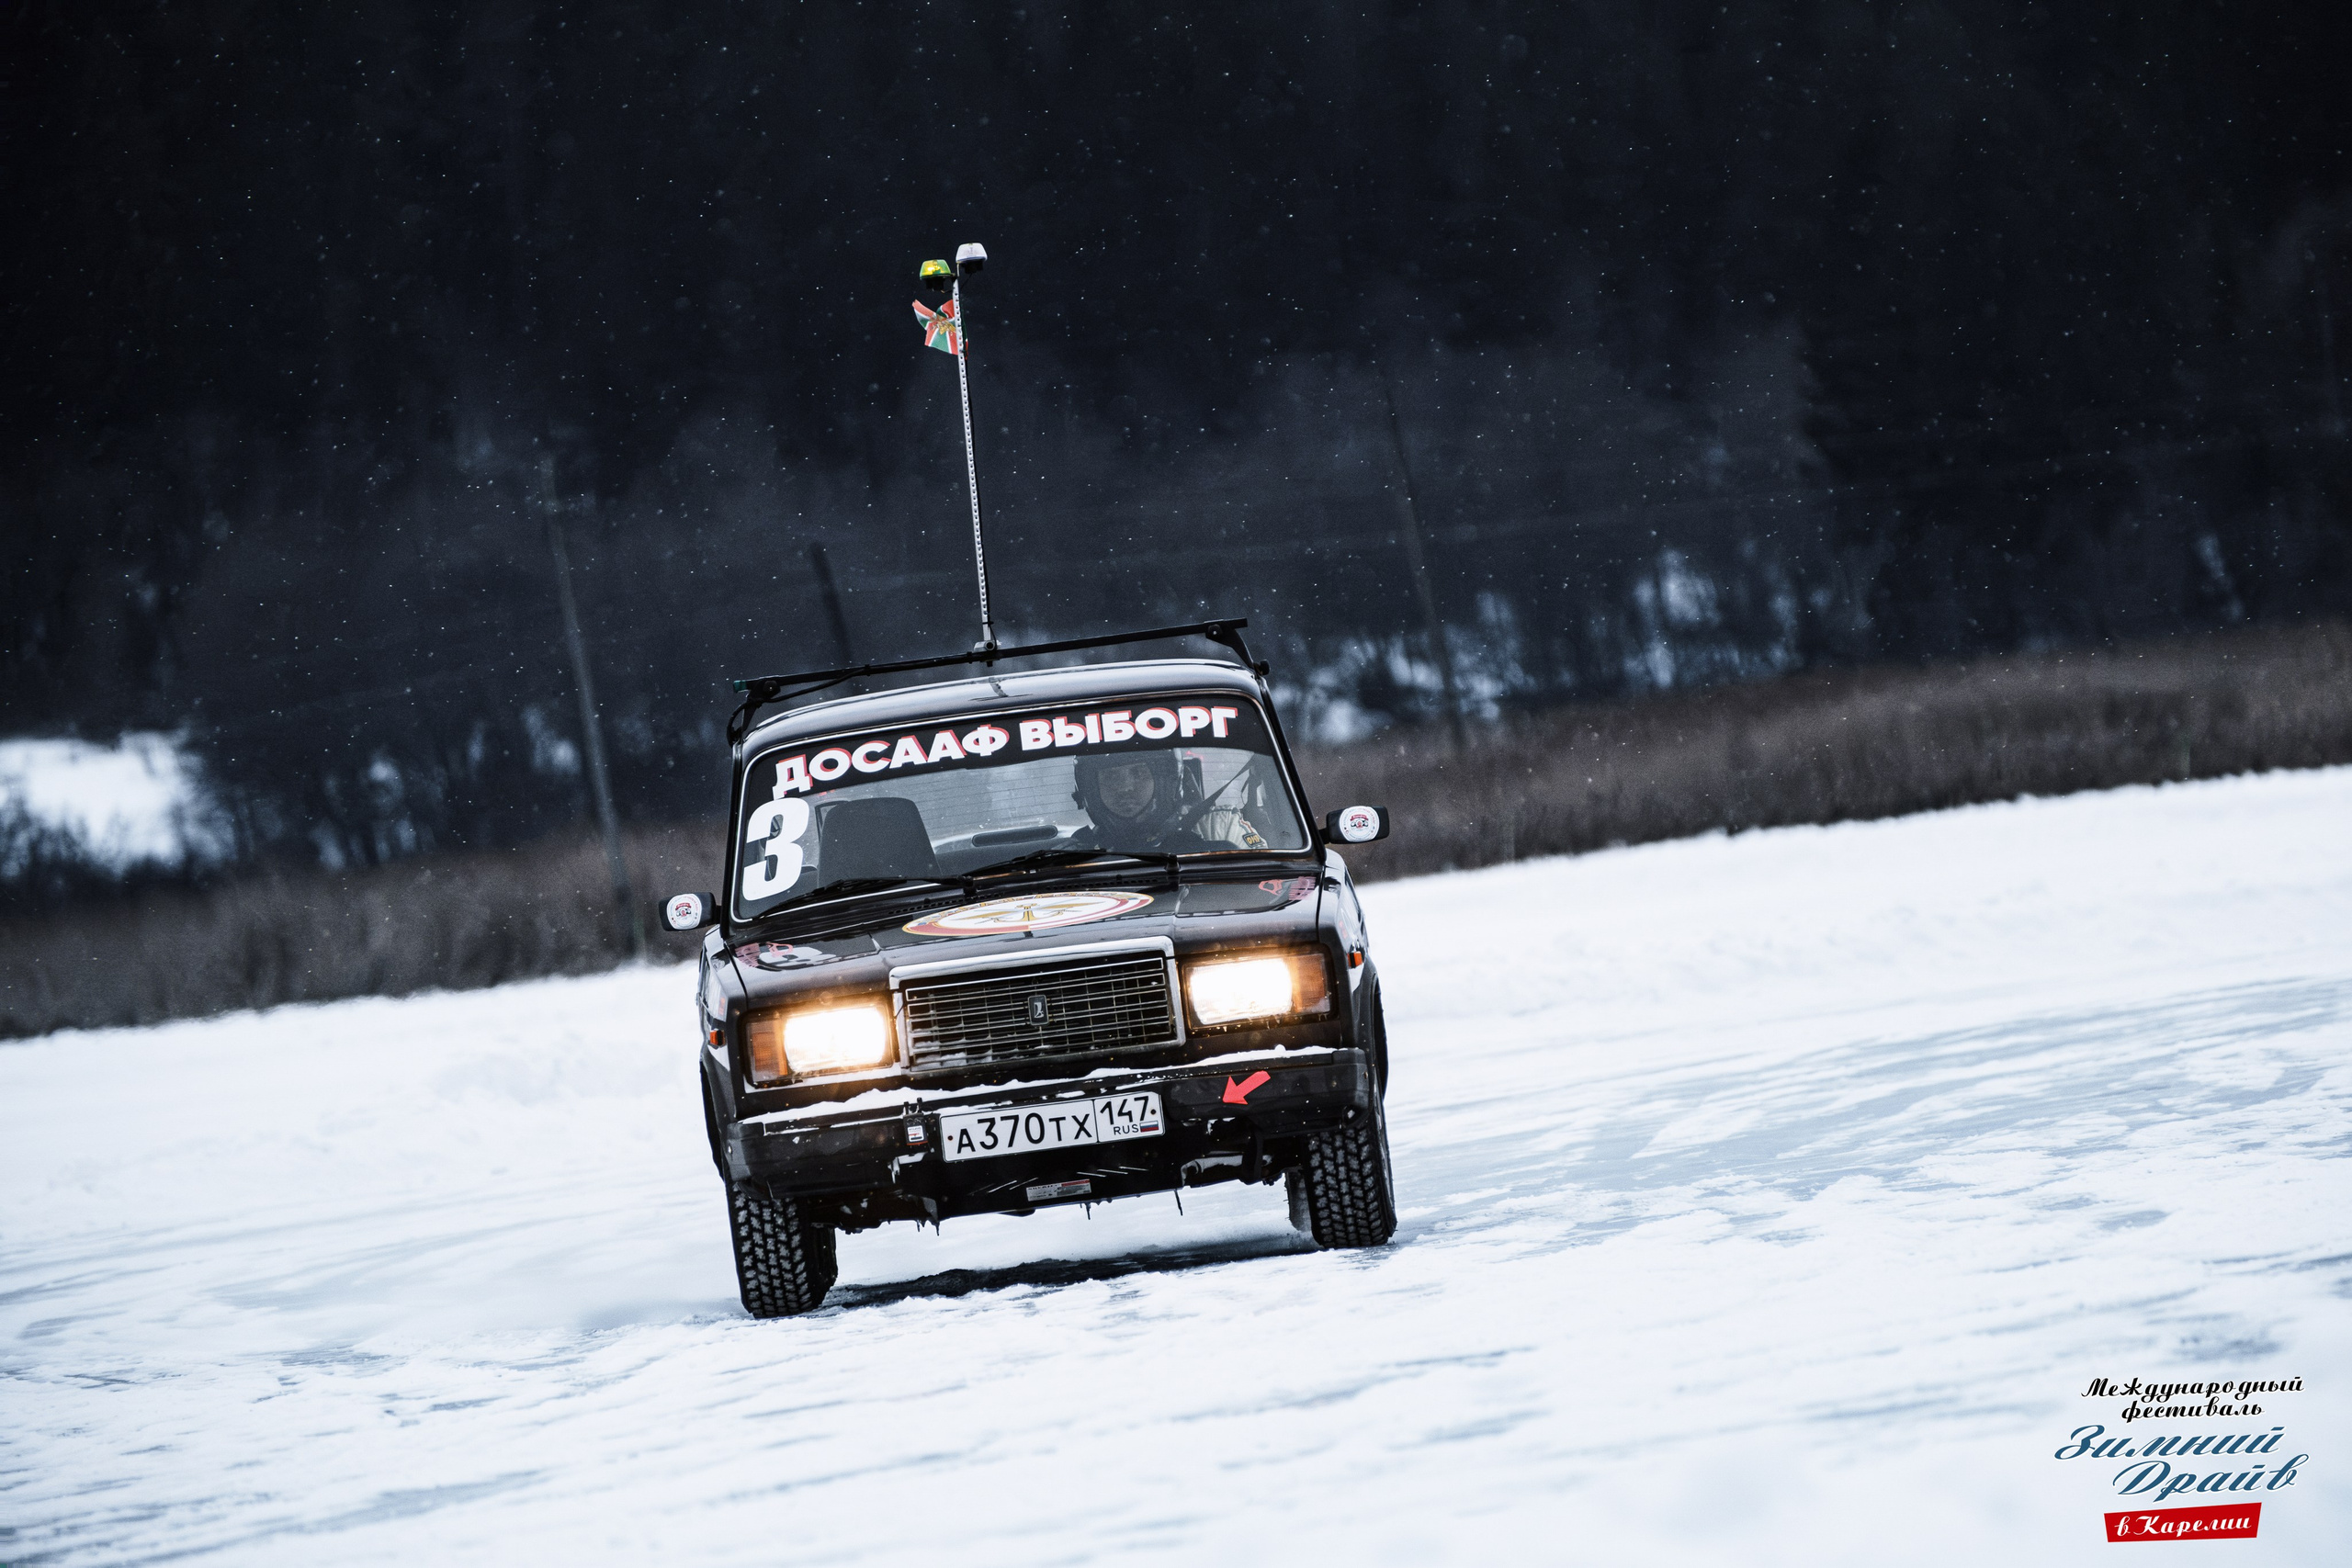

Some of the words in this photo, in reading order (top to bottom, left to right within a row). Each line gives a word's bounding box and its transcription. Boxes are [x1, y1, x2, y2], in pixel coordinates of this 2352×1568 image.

[772, 724, 1010, 799] ДОСААФ
[1019, 706, 1238, 751] ВЫБОРГ
[742, 797, 810, 901] 3
[1100, 1096, 1150, 1125] 147
[1113, 1123, 1139, 1135] RUS
